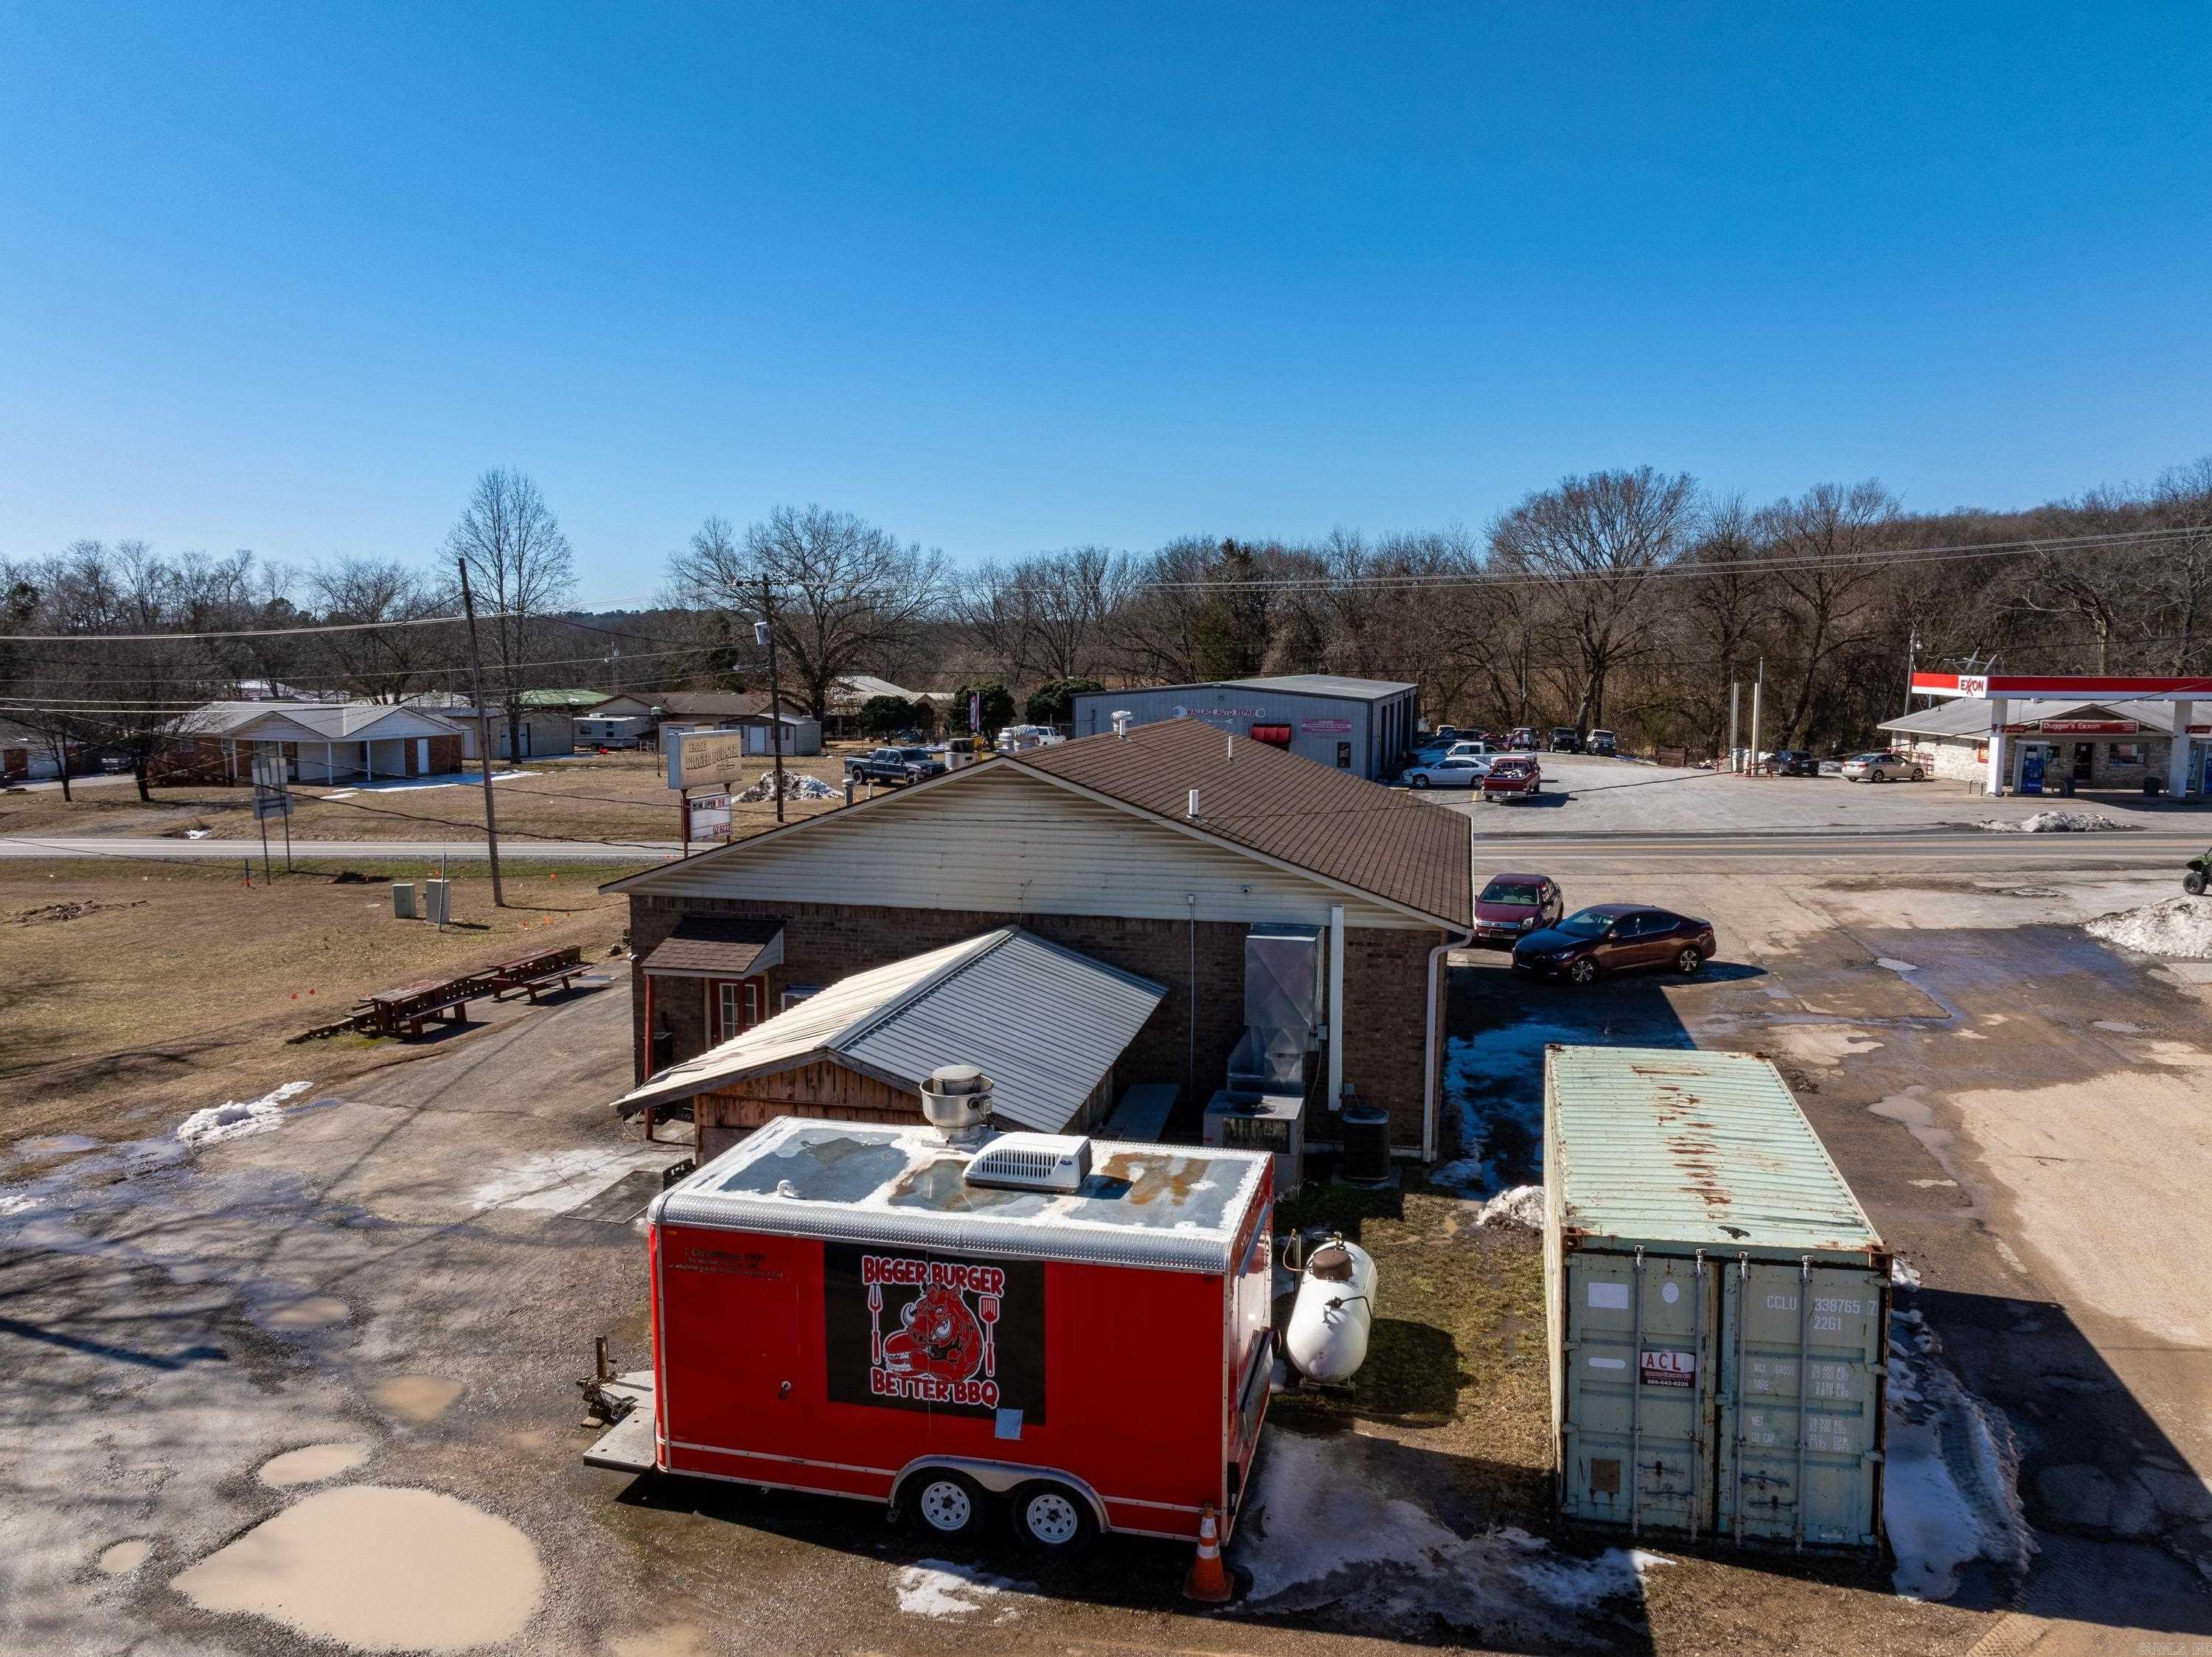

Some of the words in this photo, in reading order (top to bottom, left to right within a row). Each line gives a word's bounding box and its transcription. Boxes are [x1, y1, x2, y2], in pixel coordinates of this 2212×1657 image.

[1961, 678, 1984, 696] EXXON
[686, 752, 711, 769] BIGGER
[713, 745, 738, 764] BURGER
[693, 802, 703, 810] NOW
[705, 799, 715, 808] OPEN
[862, 1256, 928, 1285] BIGGER
[930, 1262, 1005, 1297] BURGER
[1767, 1295, 1797, 1310] CCLU
[1815, 1298, 1860, 1314] 338765
[1868, 1299, 1879, 1315] 7
[1646, 1352, 1681, 1371] ACL
[1775, 1364, 1795, 1376] GROSS
[871, 1367, 951, 1402] BETTER
[953, 1380, 1000, 1409] BBQ
[1753, 1379, 1770, 1392] TARE
[1752, 1415, 1764, 1428] NET
